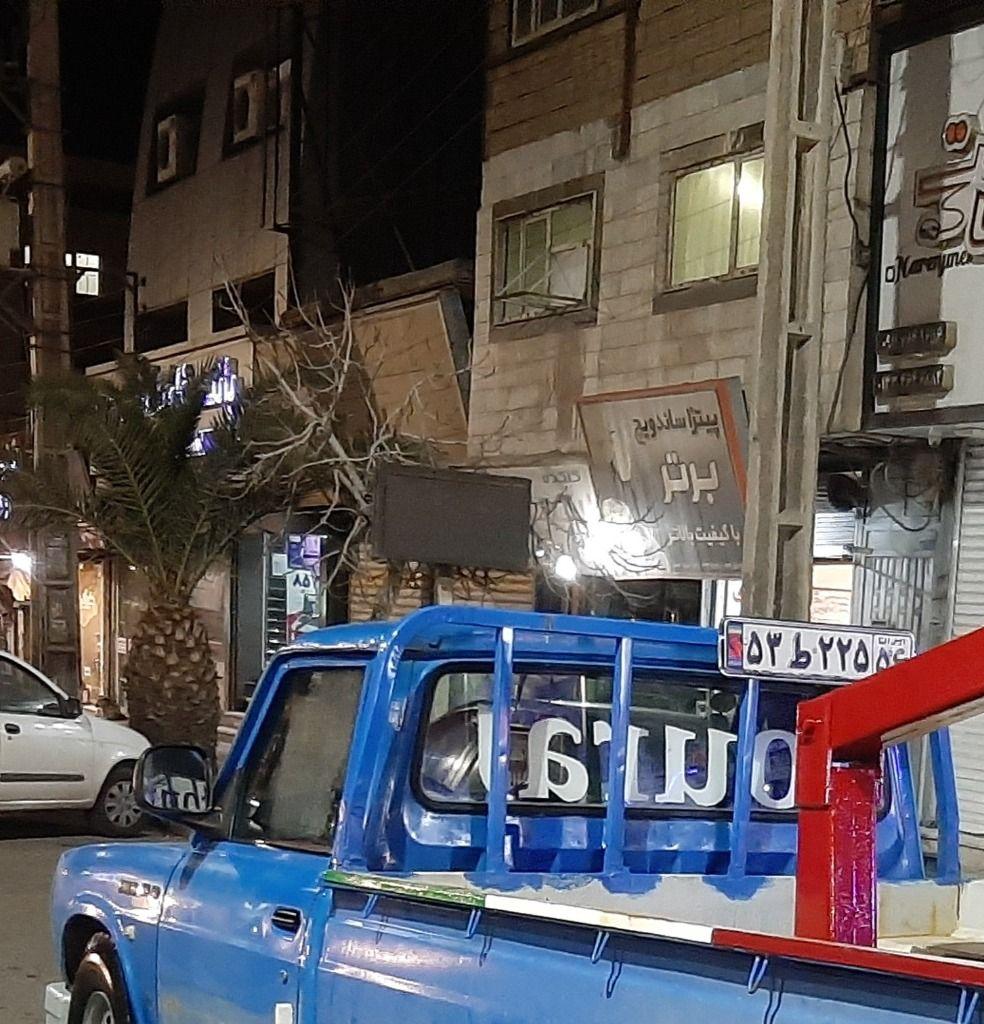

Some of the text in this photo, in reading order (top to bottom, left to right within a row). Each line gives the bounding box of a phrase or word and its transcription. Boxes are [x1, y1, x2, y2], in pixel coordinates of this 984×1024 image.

[685, 406, 720, 439] پیتزا
[660, 451, 719, 504] برتر
[695, 523, 729, 547] کیفیت
[746, 629, 870, 673] ۵۳ ط ۲۲۵
